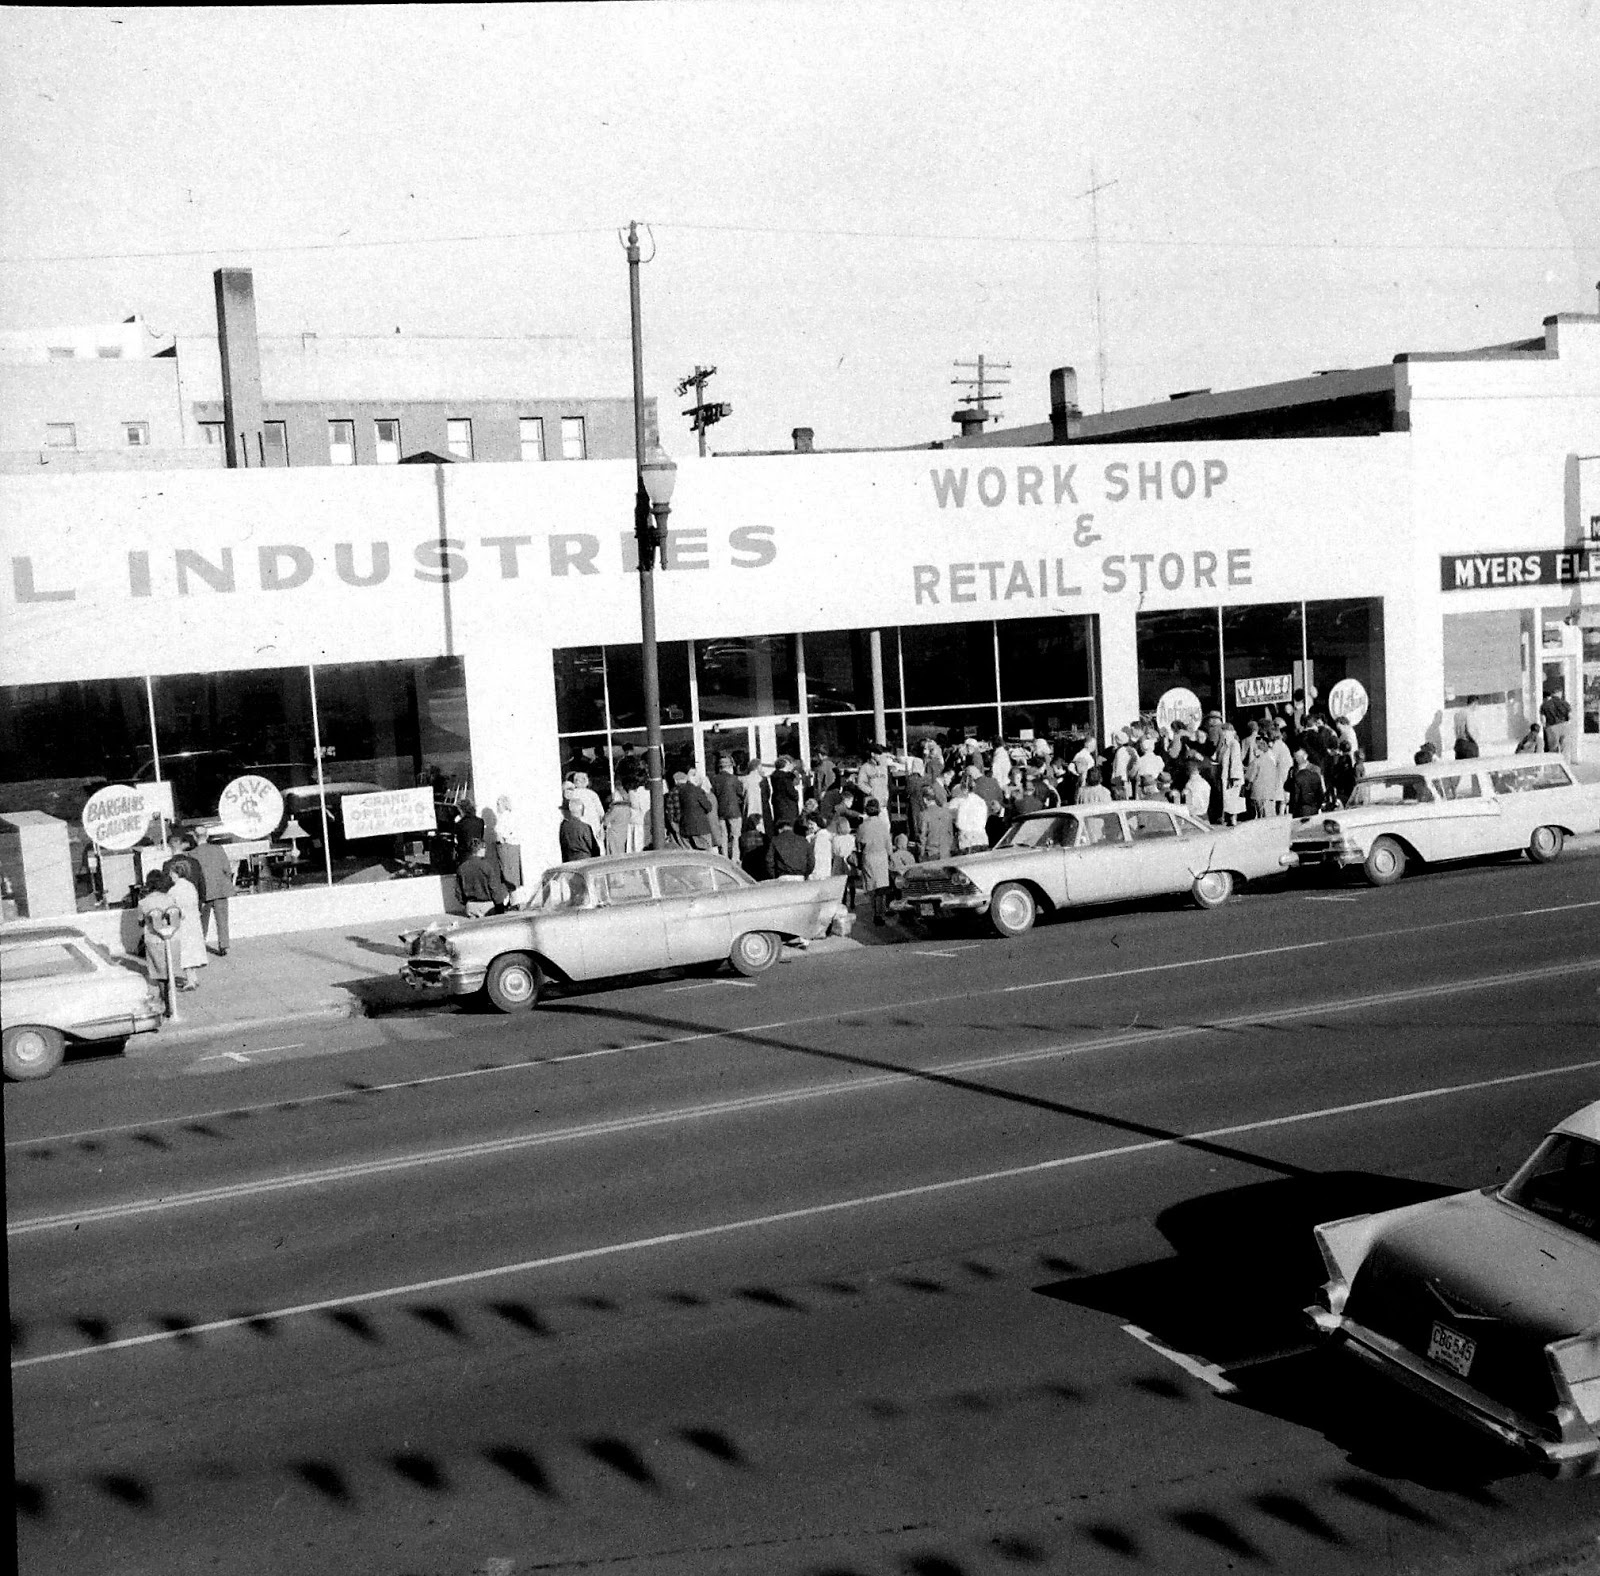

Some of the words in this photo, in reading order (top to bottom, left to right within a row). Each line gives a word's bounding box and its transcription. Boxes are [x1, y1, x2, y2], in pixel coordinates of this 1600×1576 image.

[931, 465, 1078, 509] WORK
[1105, 459, 1228, 502] SHOP
[1074, 514, 1102, 546] &
[12, 557, 75, 603] L
[128, 524, 778, 597] INDUSTRIES
[914, 558, 1082, 604] RETAIL
[1102, 548, 1252, 592] STORE
[1454, 555, 1542, 587] MYERS
[225, 779, 272, 803] SAVE
[87, 796, 145, 823] BARGAINS
[96, 815, 142, 841] GALORE
